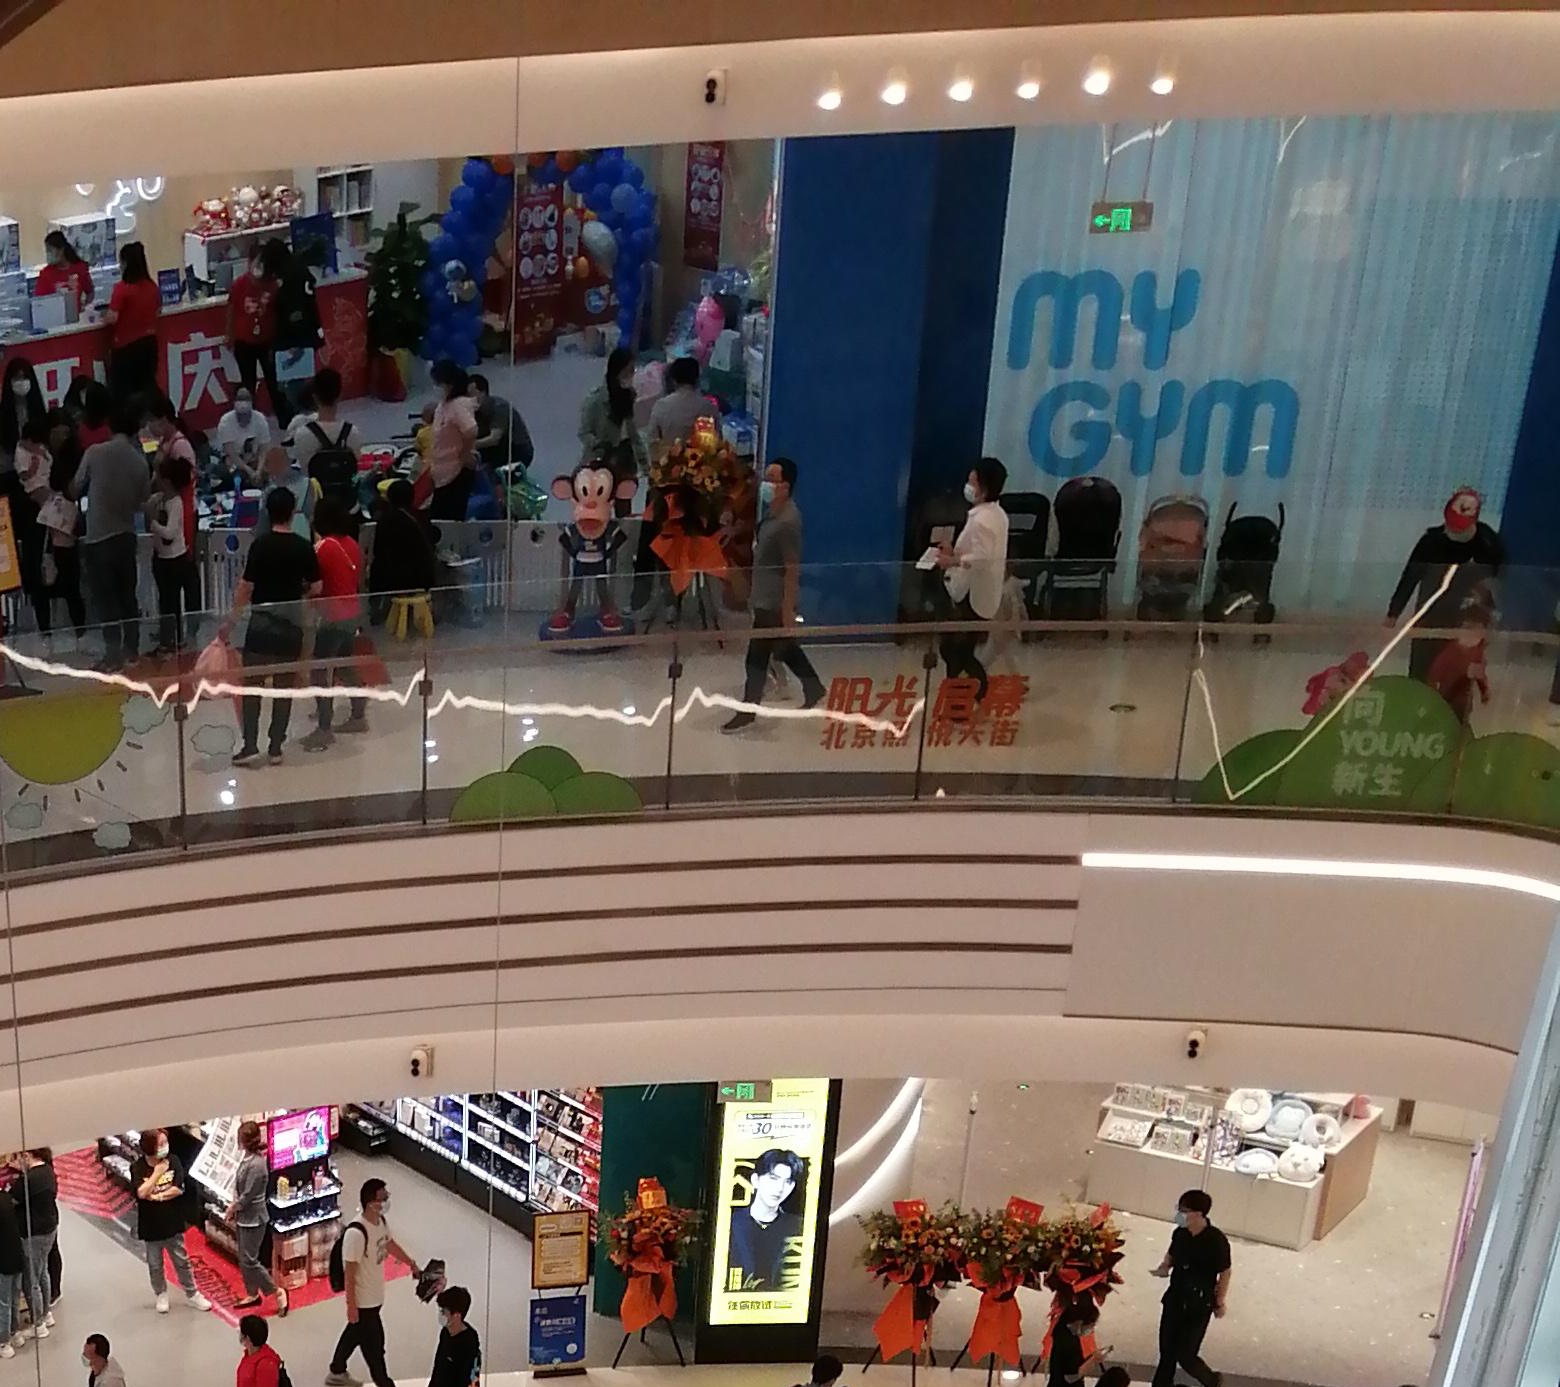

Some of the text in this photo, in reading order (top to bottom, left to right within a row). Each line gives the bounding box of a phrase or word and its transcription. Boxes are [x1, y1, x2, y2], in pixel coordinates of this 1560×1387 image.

[1006, 268, 1201, 371] MY
[1028, 378, 1300, 479] GYM
[826, 673, 1031, 724] 阳光启幕
[1343, 684, 1386, 725] 向
[1340, 730, 1446, 760] YOUNG
[1331, 760, 1405, 796] 新生
